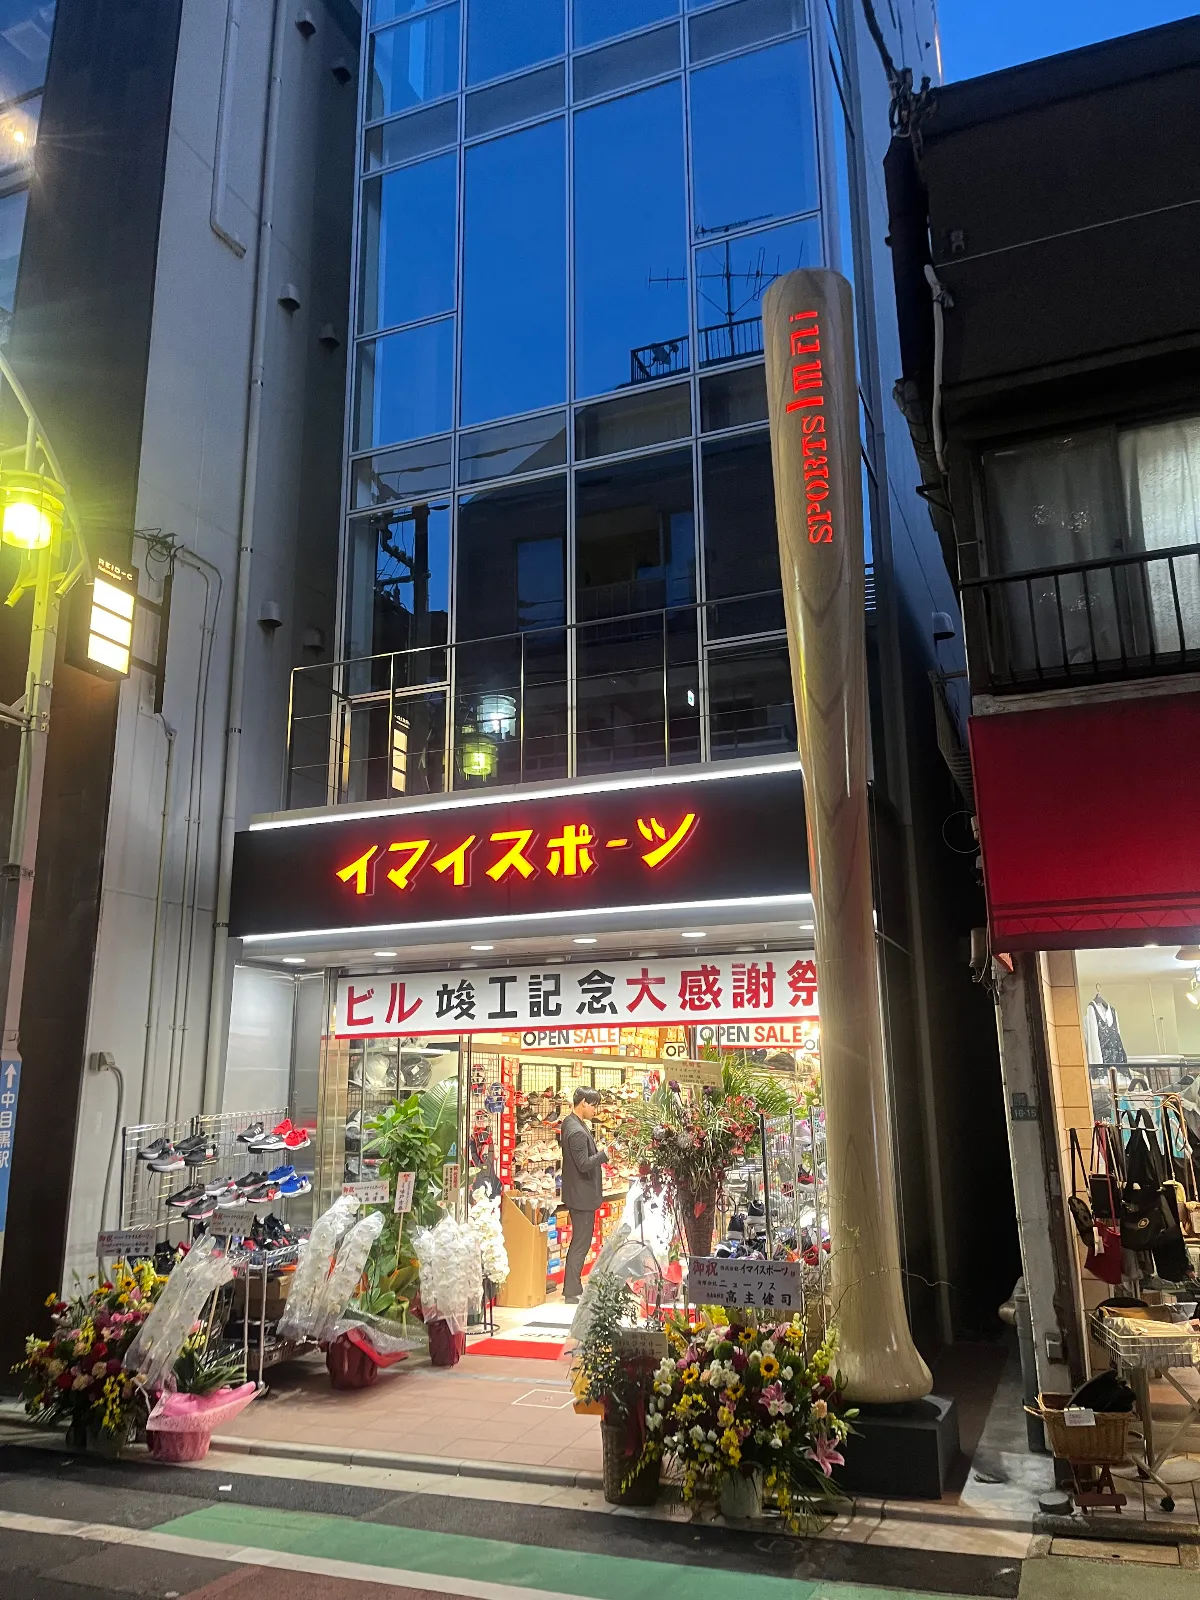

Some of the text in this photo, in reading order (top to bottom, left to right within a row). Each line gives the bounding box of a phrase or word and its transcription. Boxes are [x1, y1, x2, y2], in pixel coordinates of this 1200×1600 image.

[786, 309, 833, 544] SPORTS Imai
[336, 813, 697, 895] イマイスポーツ
[523, 1027, 616, 1046] OPEN SALE
[665, 1045, 688, 1057] OP
[700, 1025, 803, 1044] OPEN SALE
[0, 1090, 15, 1168] 中目黒駅
